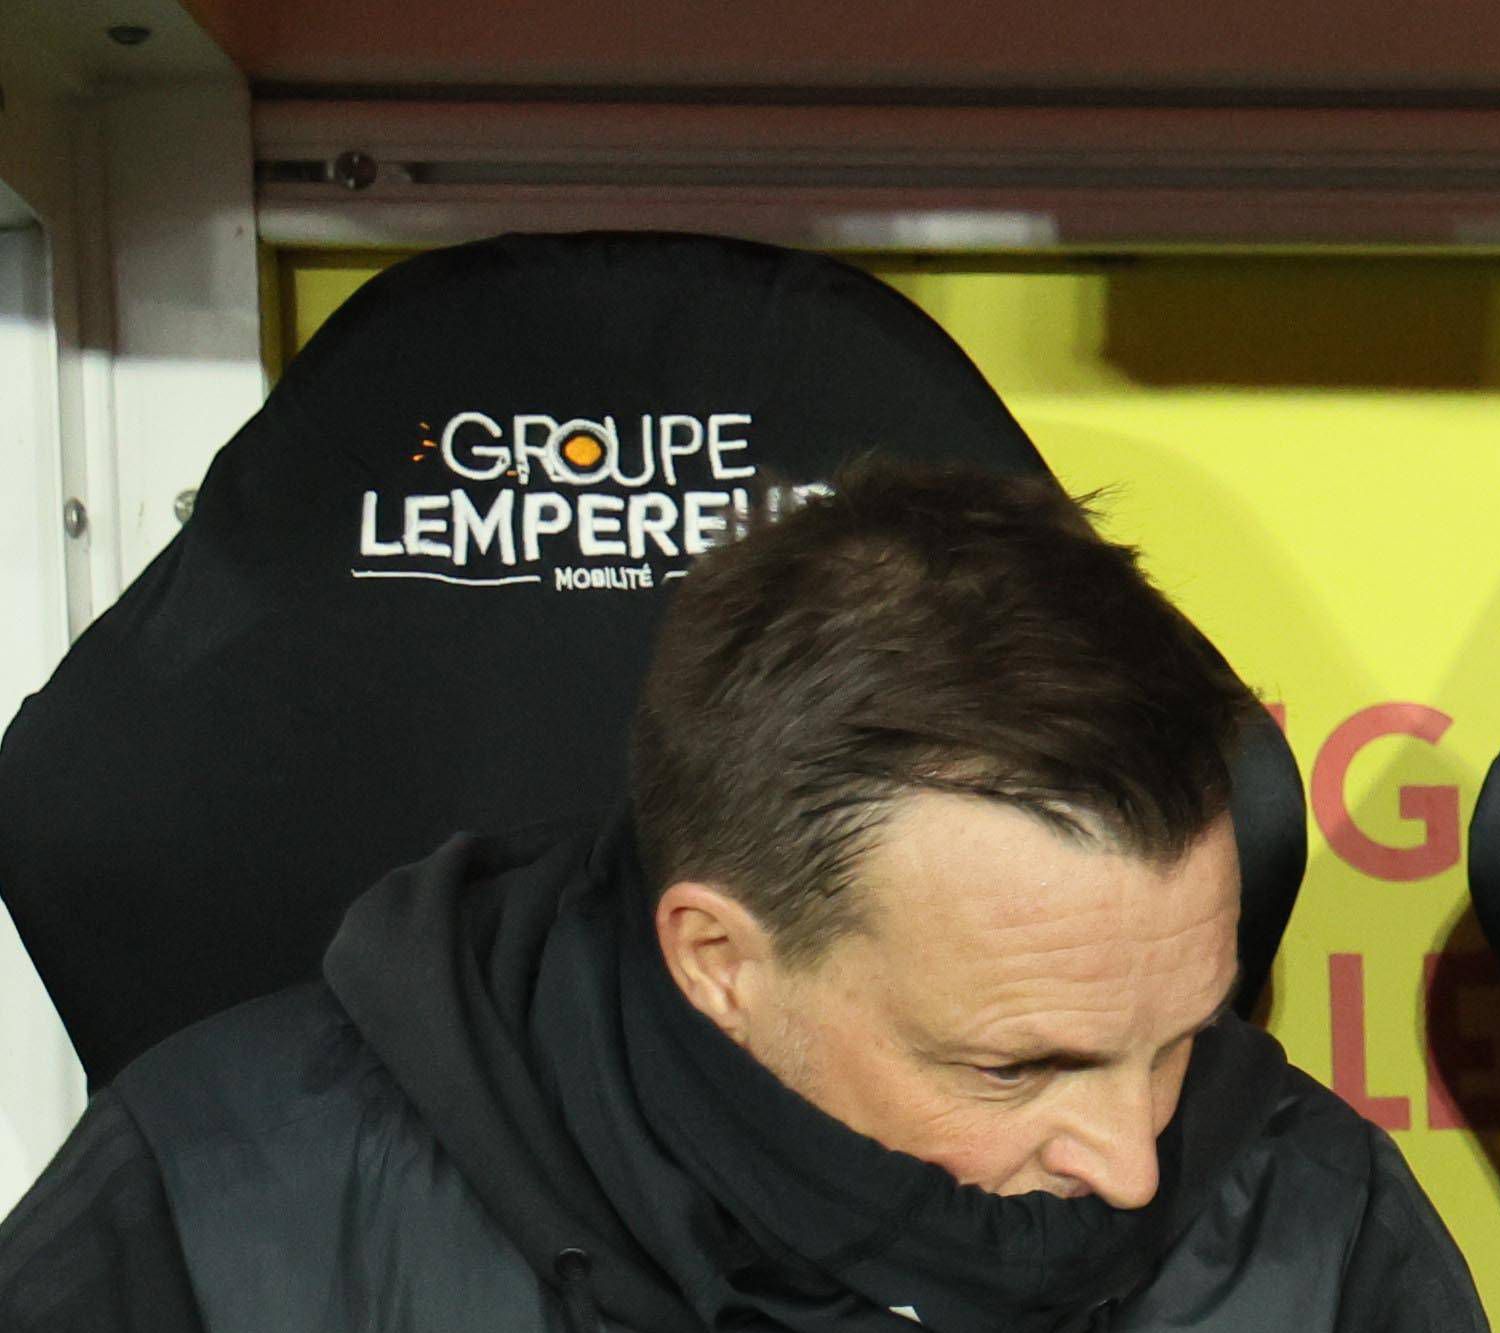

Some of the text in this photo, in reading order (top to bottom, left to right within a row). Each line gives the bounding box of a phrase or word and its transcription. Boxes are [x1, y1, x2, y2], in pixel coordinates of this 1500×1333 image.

[441, 412, 756, 487] GROUPE
[361, 483, 835, 565] LEMPERE
[554, 563, 653, 590] MOBILITÉ
